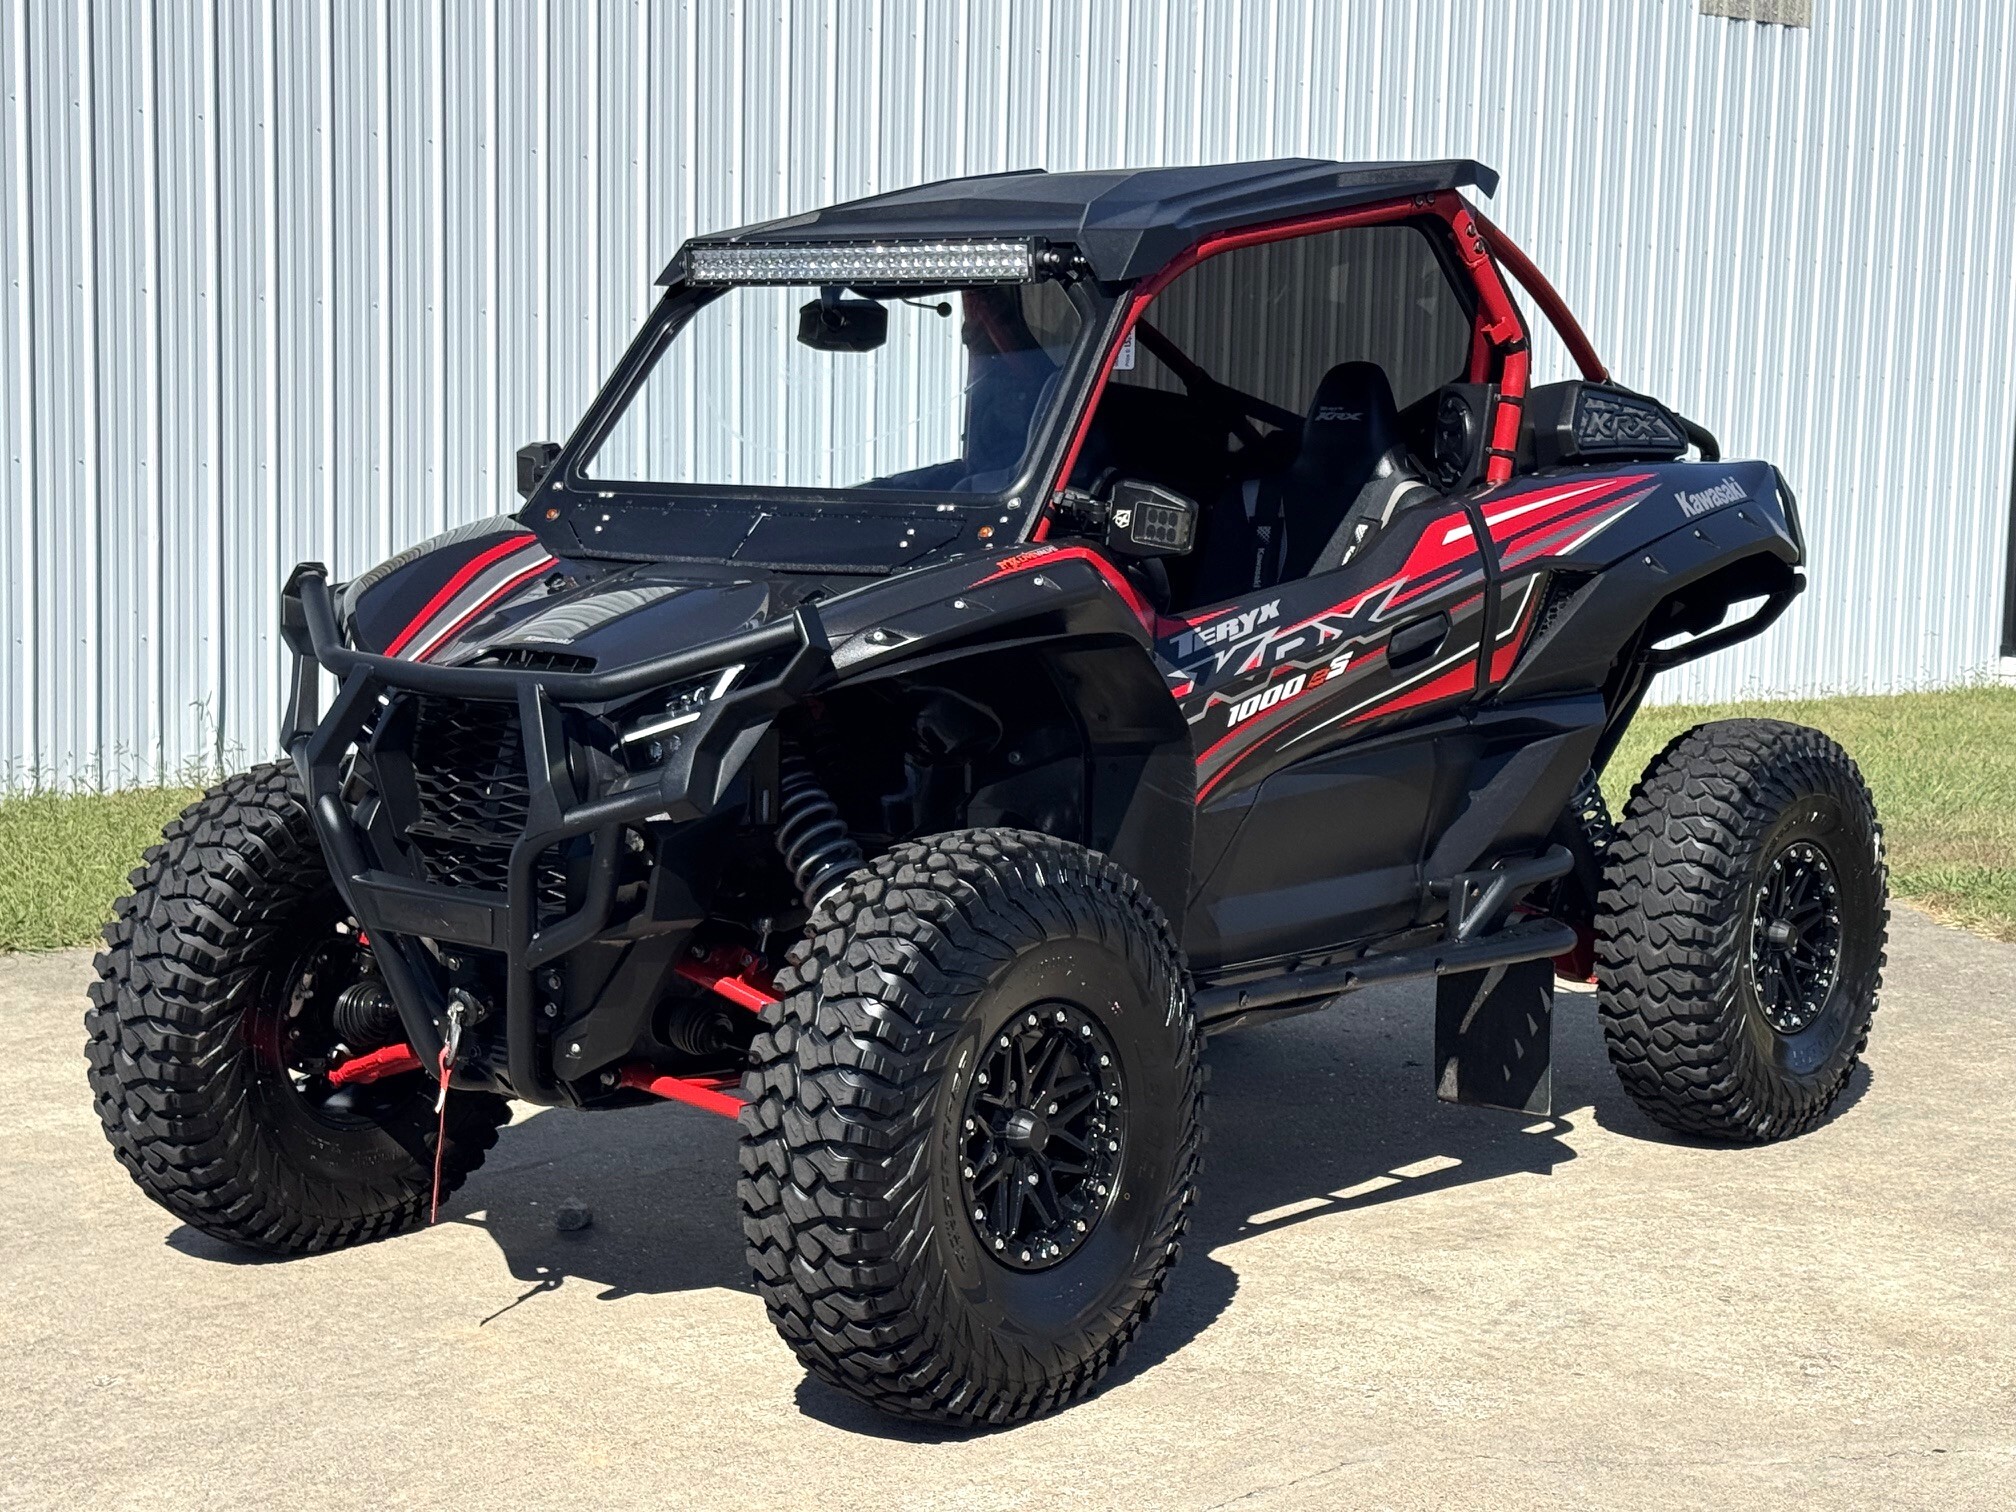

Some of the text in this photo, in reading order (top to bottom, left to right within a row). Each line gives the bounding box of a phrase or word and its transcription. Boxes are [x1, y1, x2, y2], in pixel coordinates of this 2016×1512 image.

[1314, 411, 1363, 421] KRX
[1581, 407, 1673, 438] KRX
[1674, 476, 1748, 518] Kawasaki
[1169, 598, 1281, 659] TERYX
[1226, 673, 1307, 728] 1000
